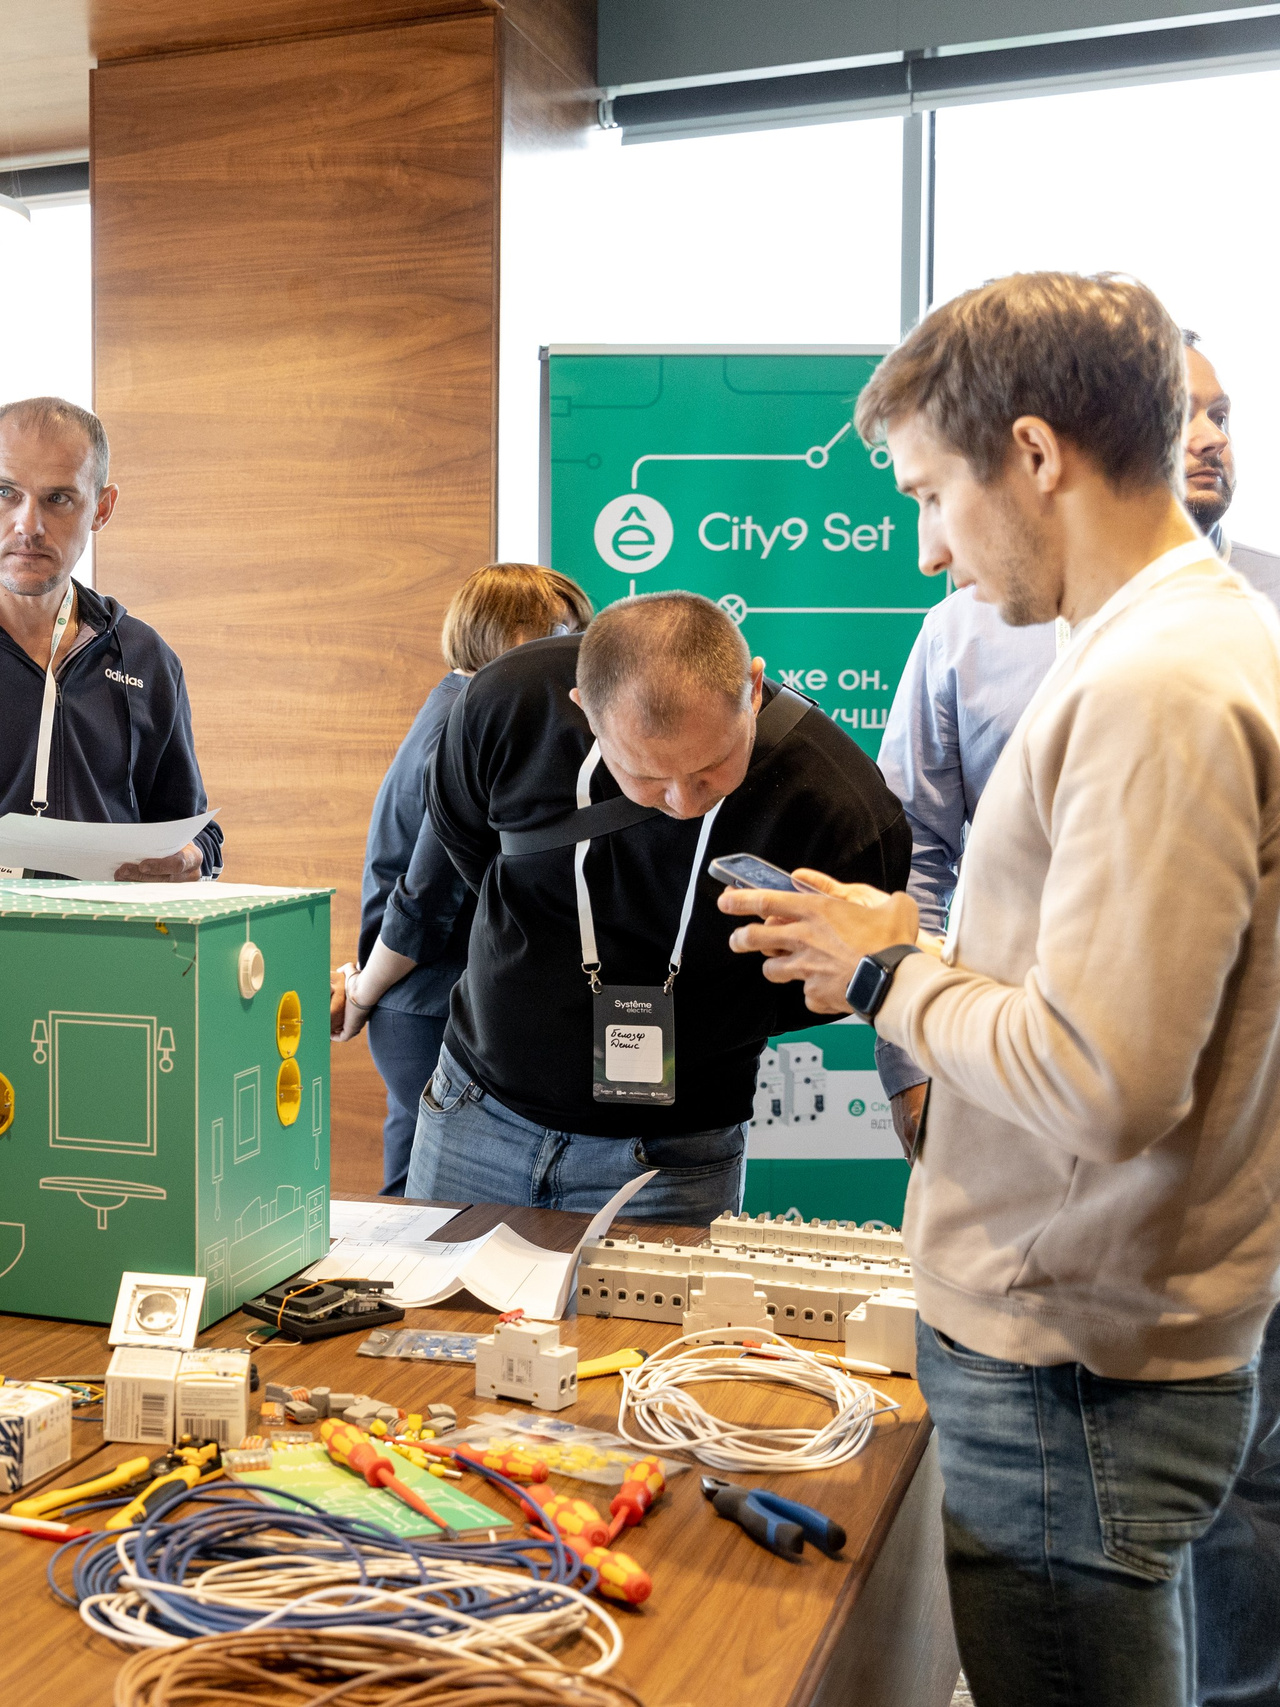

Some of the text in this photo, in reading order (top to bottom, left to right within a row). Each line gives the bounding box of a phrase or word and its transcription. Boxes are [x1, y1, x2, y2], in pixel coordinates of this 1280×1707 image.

[698, 512, 895, 559] City9 Set
[105, 668, 144, 689] adidas
[838, 669, 889, 691] он.
